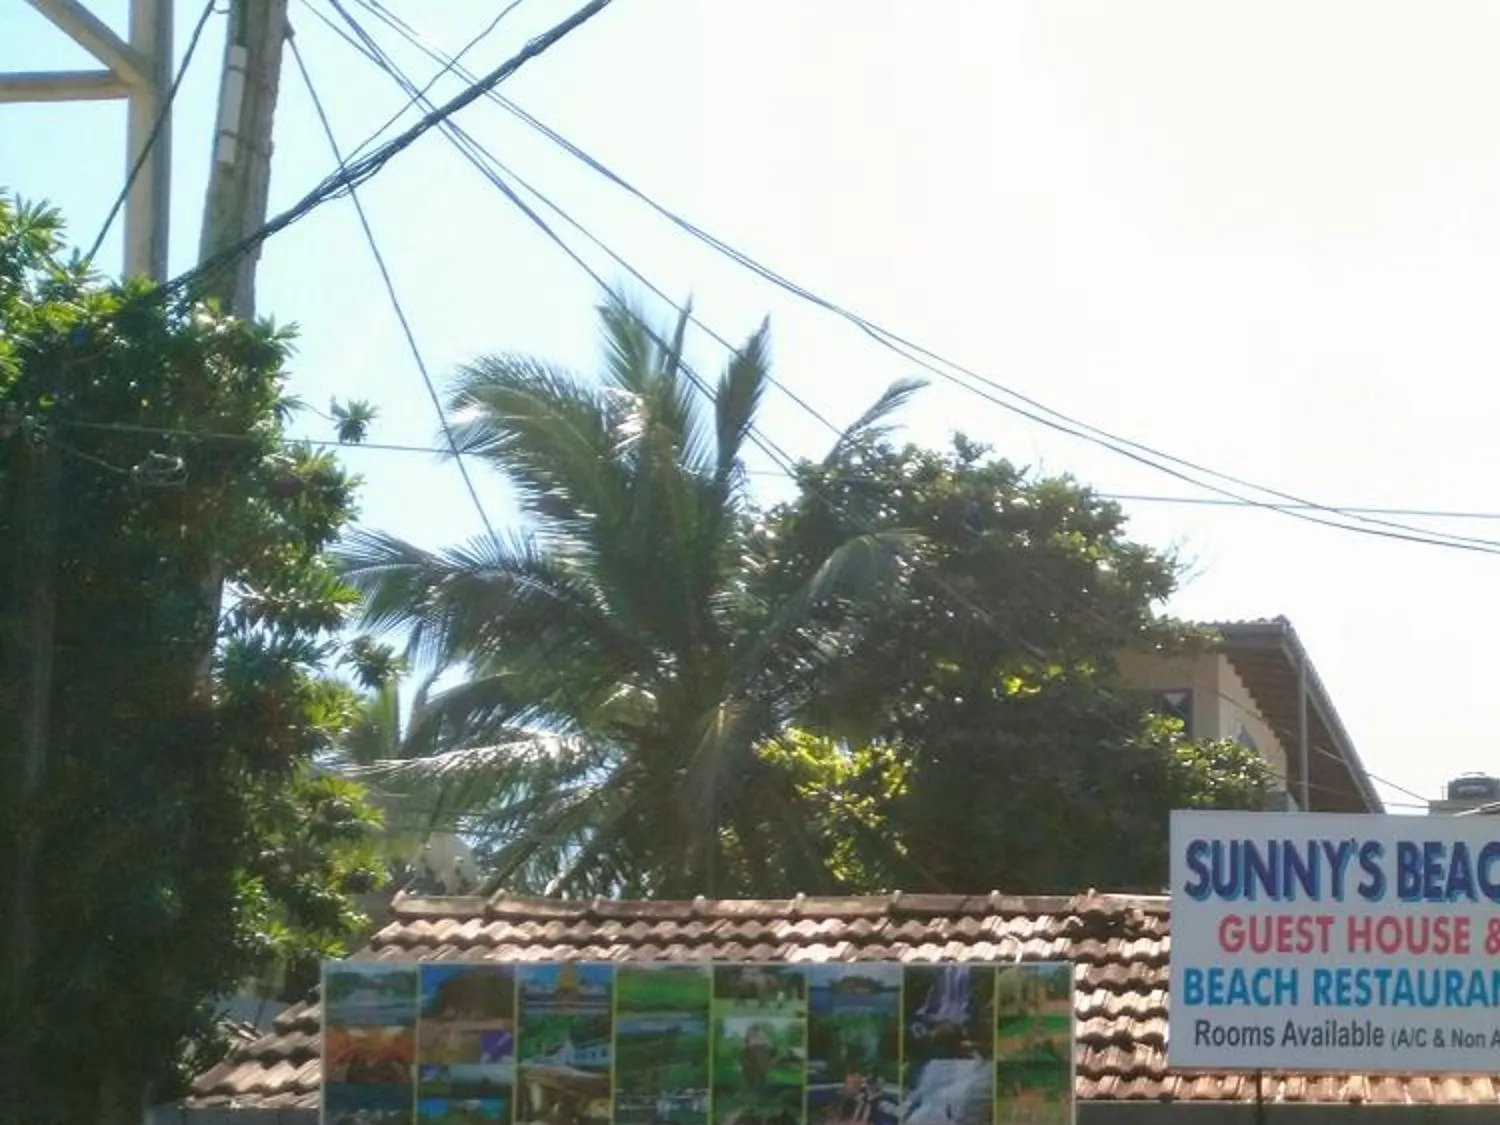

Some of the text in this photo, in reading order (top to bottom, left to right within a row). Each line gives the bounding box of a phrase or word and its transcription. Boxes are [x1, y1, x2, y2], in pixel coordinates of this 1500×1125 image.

[1184, 838, 1386, 902] SUNNY'S
[1218, 914, 1336, 954] GUEST
[1347, 915, 1471, 955] HOUSE
[1183, 966, 1299, 1007] BEACH
[1194, 1019, 1276, 1048] Rooms
[1281, 1019, 1385, 1049] Available
[1391, 1027, 1428, 1052] (A/C
[1433, 1028, 1447, 1049] &
[1451, 1027, 1487, 1049] Non
